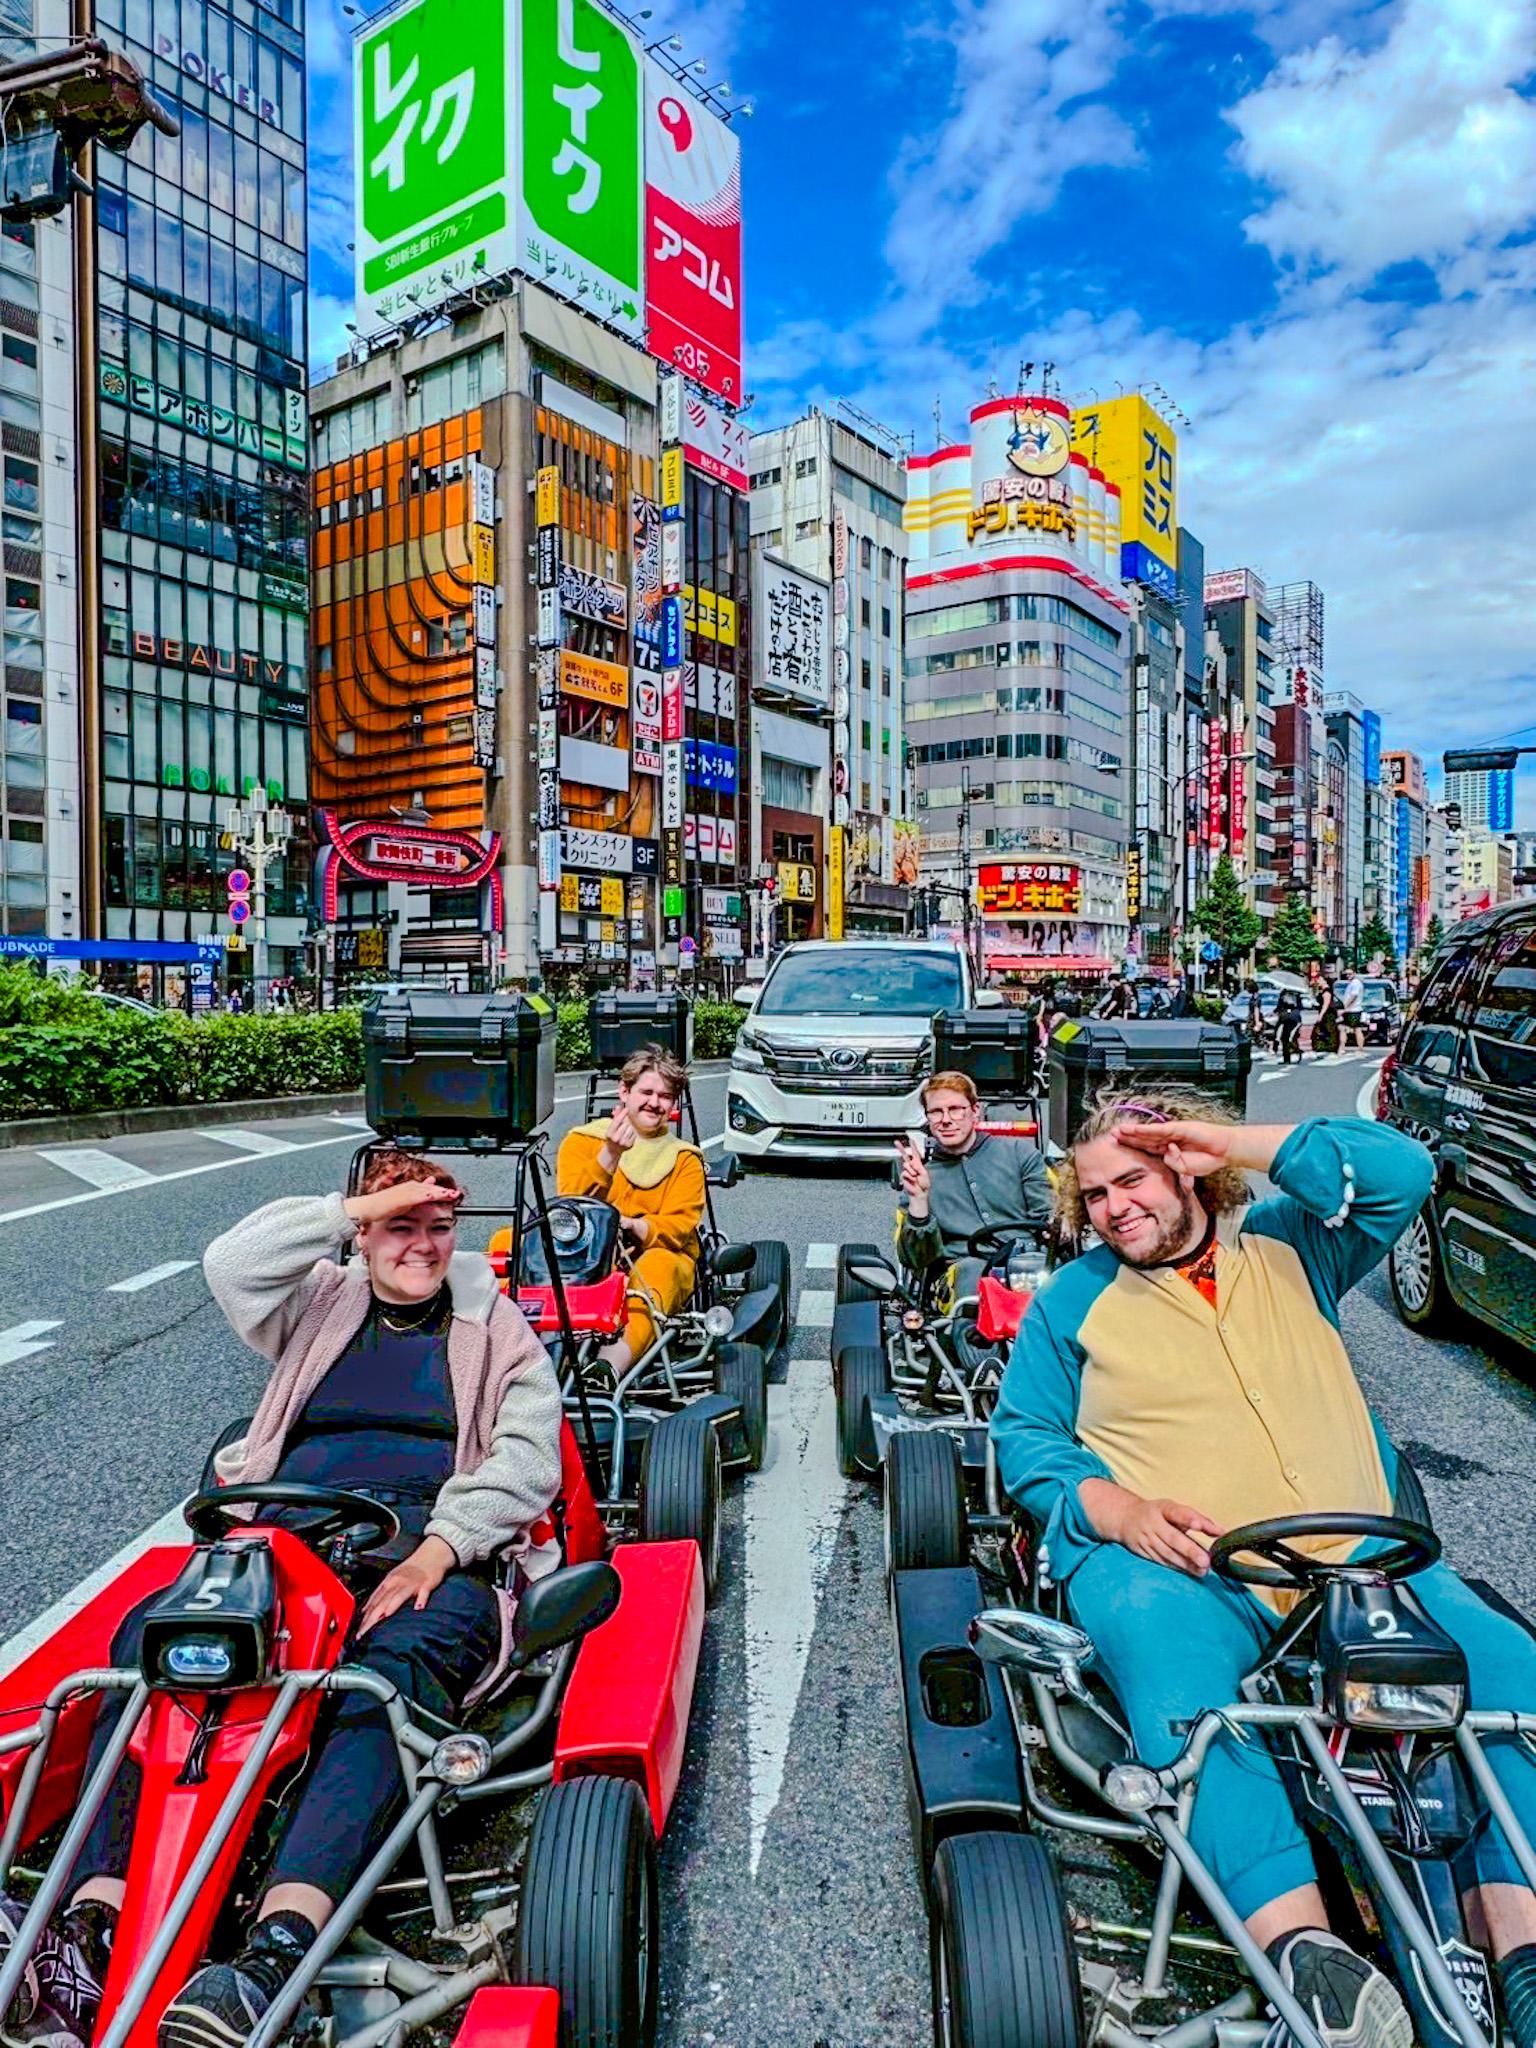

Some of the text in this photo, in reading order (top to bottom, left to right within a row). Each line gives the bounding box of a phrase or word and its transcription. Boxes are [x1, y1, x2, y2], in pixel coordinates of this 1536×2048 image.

[155, 33, 280, 128] POKER
[551, 0, 604, 214] レイク
[653, 215, 735, 310] アコム
[288, 393, 302, 433] ダーツ
[134, 630, 284, 685] BEAUTY
[635, 640, 660, 670] 7F
[609, 681, 624, 698] 6F
[636, 753, 660, 768] ATM
[569, 831, 628, 851] メンズライフ
[636, 846, 656, 865] 3F
[569, 849, 617, 868] クリニック
[183, 1576, 232, 1611] 5
[1366, 1609, 1414, 1641] 2
